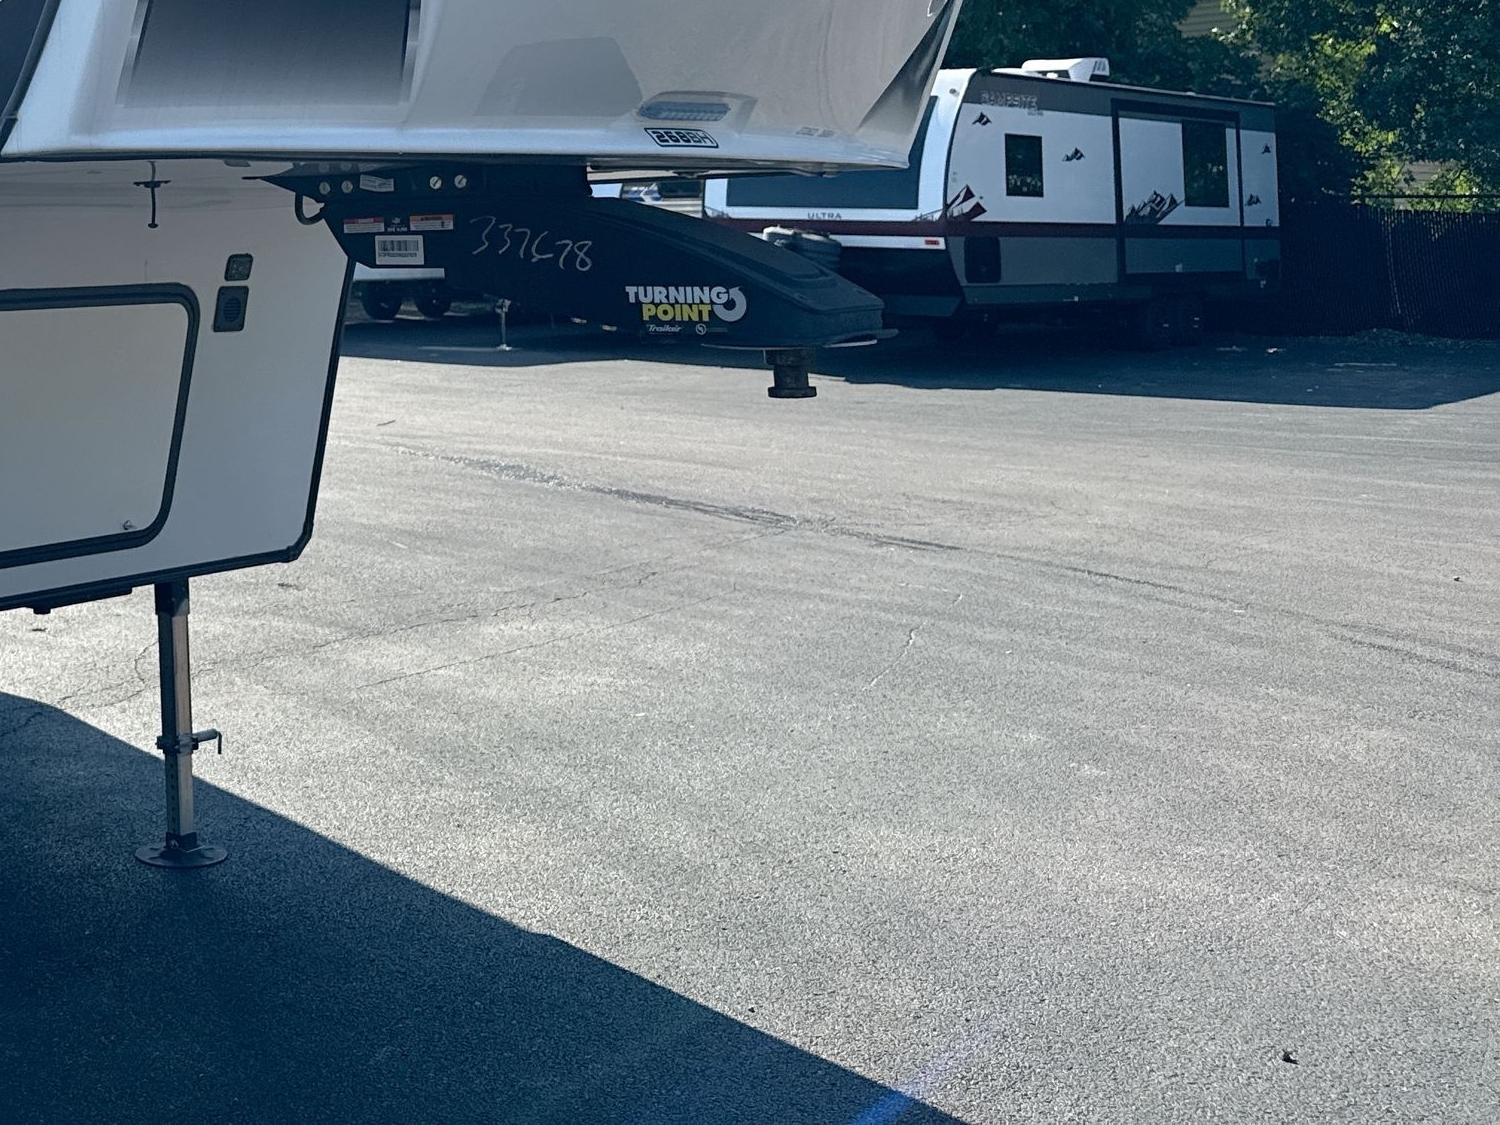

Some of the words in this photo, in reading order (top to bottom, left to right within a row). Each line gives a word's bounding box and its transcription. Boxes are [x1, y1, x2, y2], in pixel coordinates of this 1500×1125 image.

[651, 130, 714, 145] 268BH
[807, 211, 842, 220] ULTRA
[625, 285, 729, 304] TURNING
[641, 303, 712, 322] POINT
